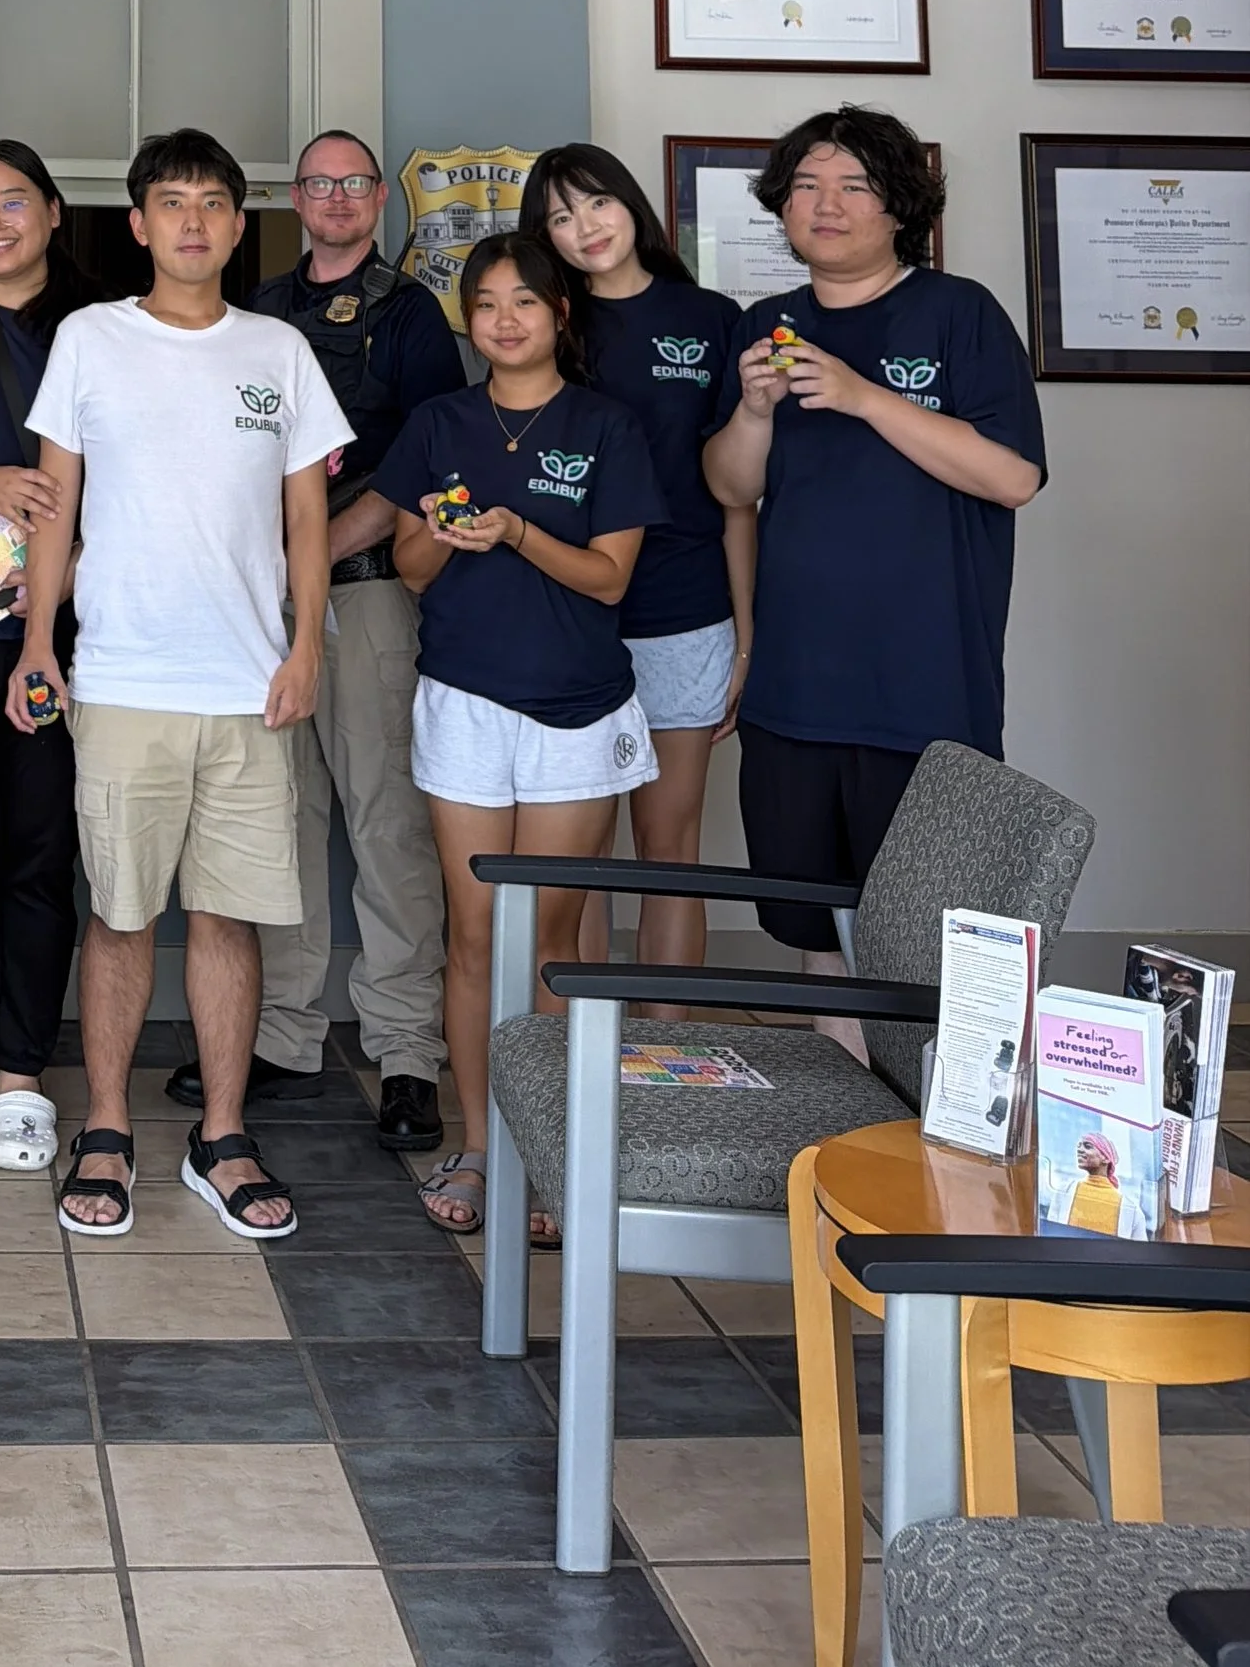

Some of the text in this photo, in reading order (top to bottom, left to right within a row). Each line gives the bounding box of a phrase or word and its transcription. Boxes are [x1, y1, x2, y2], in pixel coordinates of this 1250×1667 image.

[446, 165, 522, 185] POLICE
[1148, 186, 1184, 196] CALEA
[432, 254, 463, 271] CITY
[417, 266, 449, 290] SINCE
[652, 365, 711, 382] EDUBUD
[235, 416, 281, 435] EDUBUD
[1066, 1025, 1114, 1050] Feeling
[710, 1048, 750, 1073] 2026
[1054, 1039, 1128, 1060] stressed or
[1046, 1052, 1137, 1077] overwhelmed?
[1162, 1119, 1173, 1163] GEORGIA
[1168, 1120, 1184, 1188] HANDS-FREE
